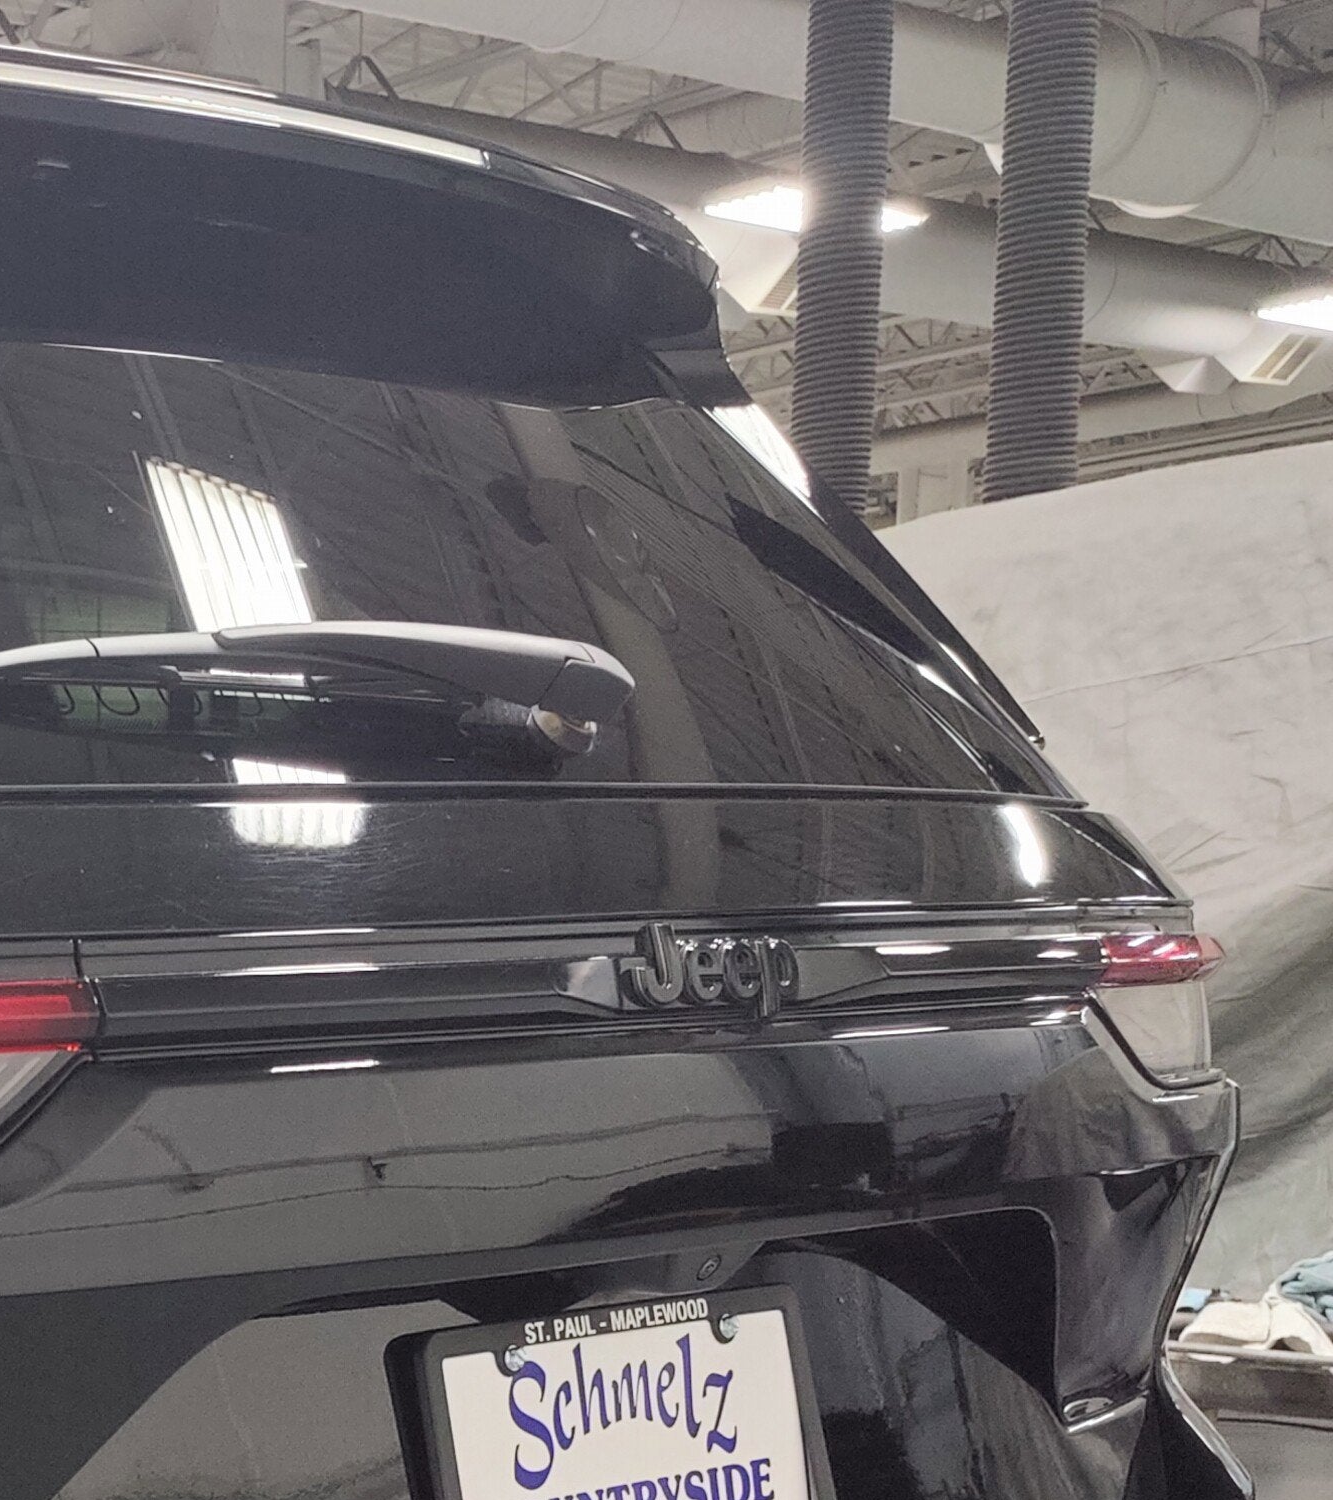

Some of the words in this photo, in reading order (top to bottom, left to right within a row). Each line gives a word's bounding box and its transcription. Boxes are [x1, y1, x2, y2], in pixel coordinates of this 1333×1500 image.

[621, 922, 800, 1018] Jeep
[524, 1321, 551, 1344] ST.
[554, 1315, 597, 1340] PAUL
[610, 1297, 709, 1332] MAPLEWOOD
[508, 1332, 738, 1491] Schmelz
